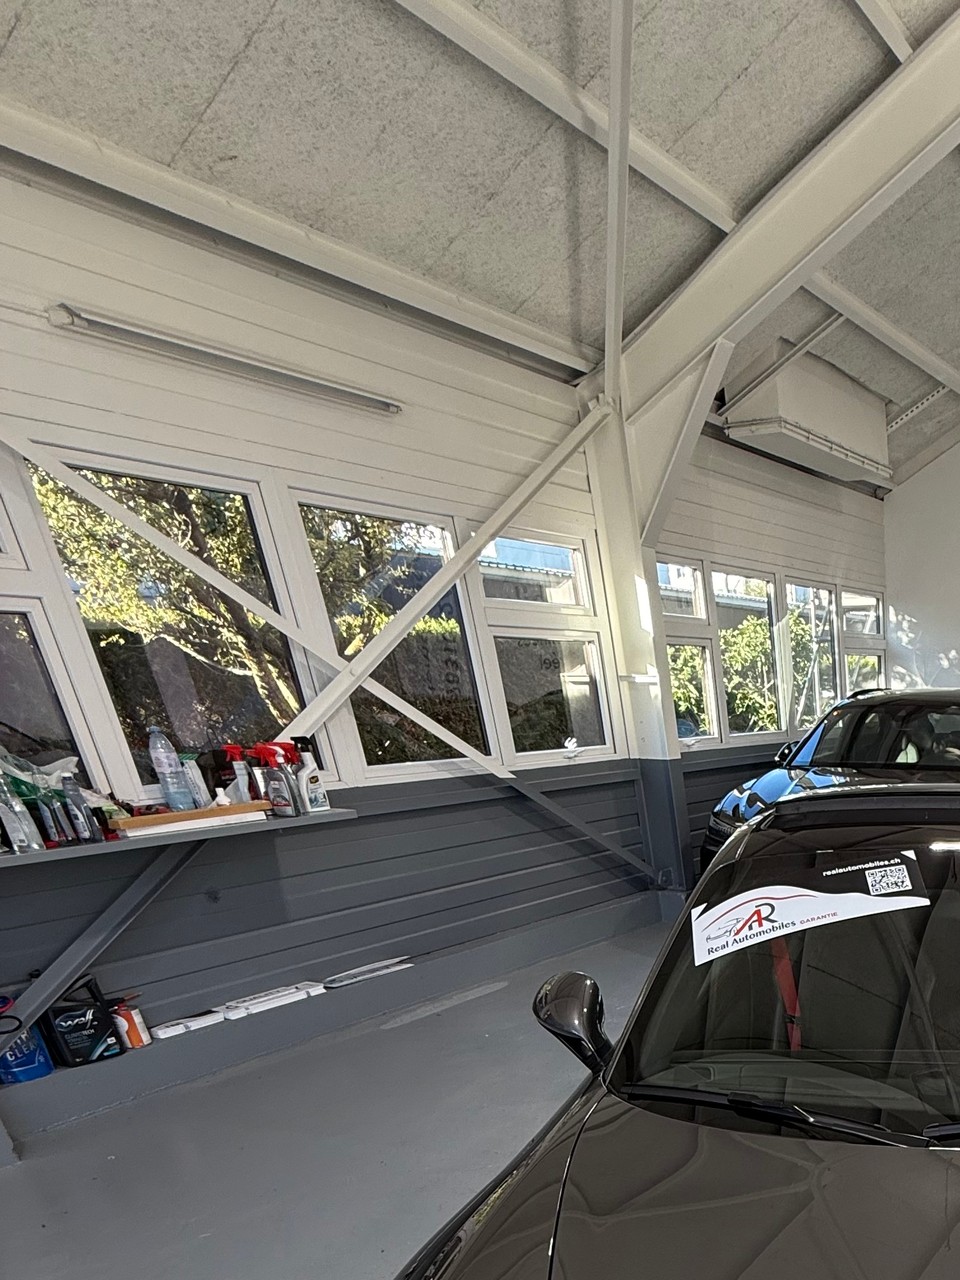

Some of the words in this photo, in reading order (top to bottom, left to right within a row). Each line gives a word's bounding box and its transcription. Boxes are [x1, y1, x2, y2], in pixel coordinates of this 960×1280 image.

[822, 858, 902, 877] realautomobiles.ch
[706, 940, 730, 956] Real
[730, 919, 797, 948] Automobiles
[799, 912, 839, 925] GARANTIE
